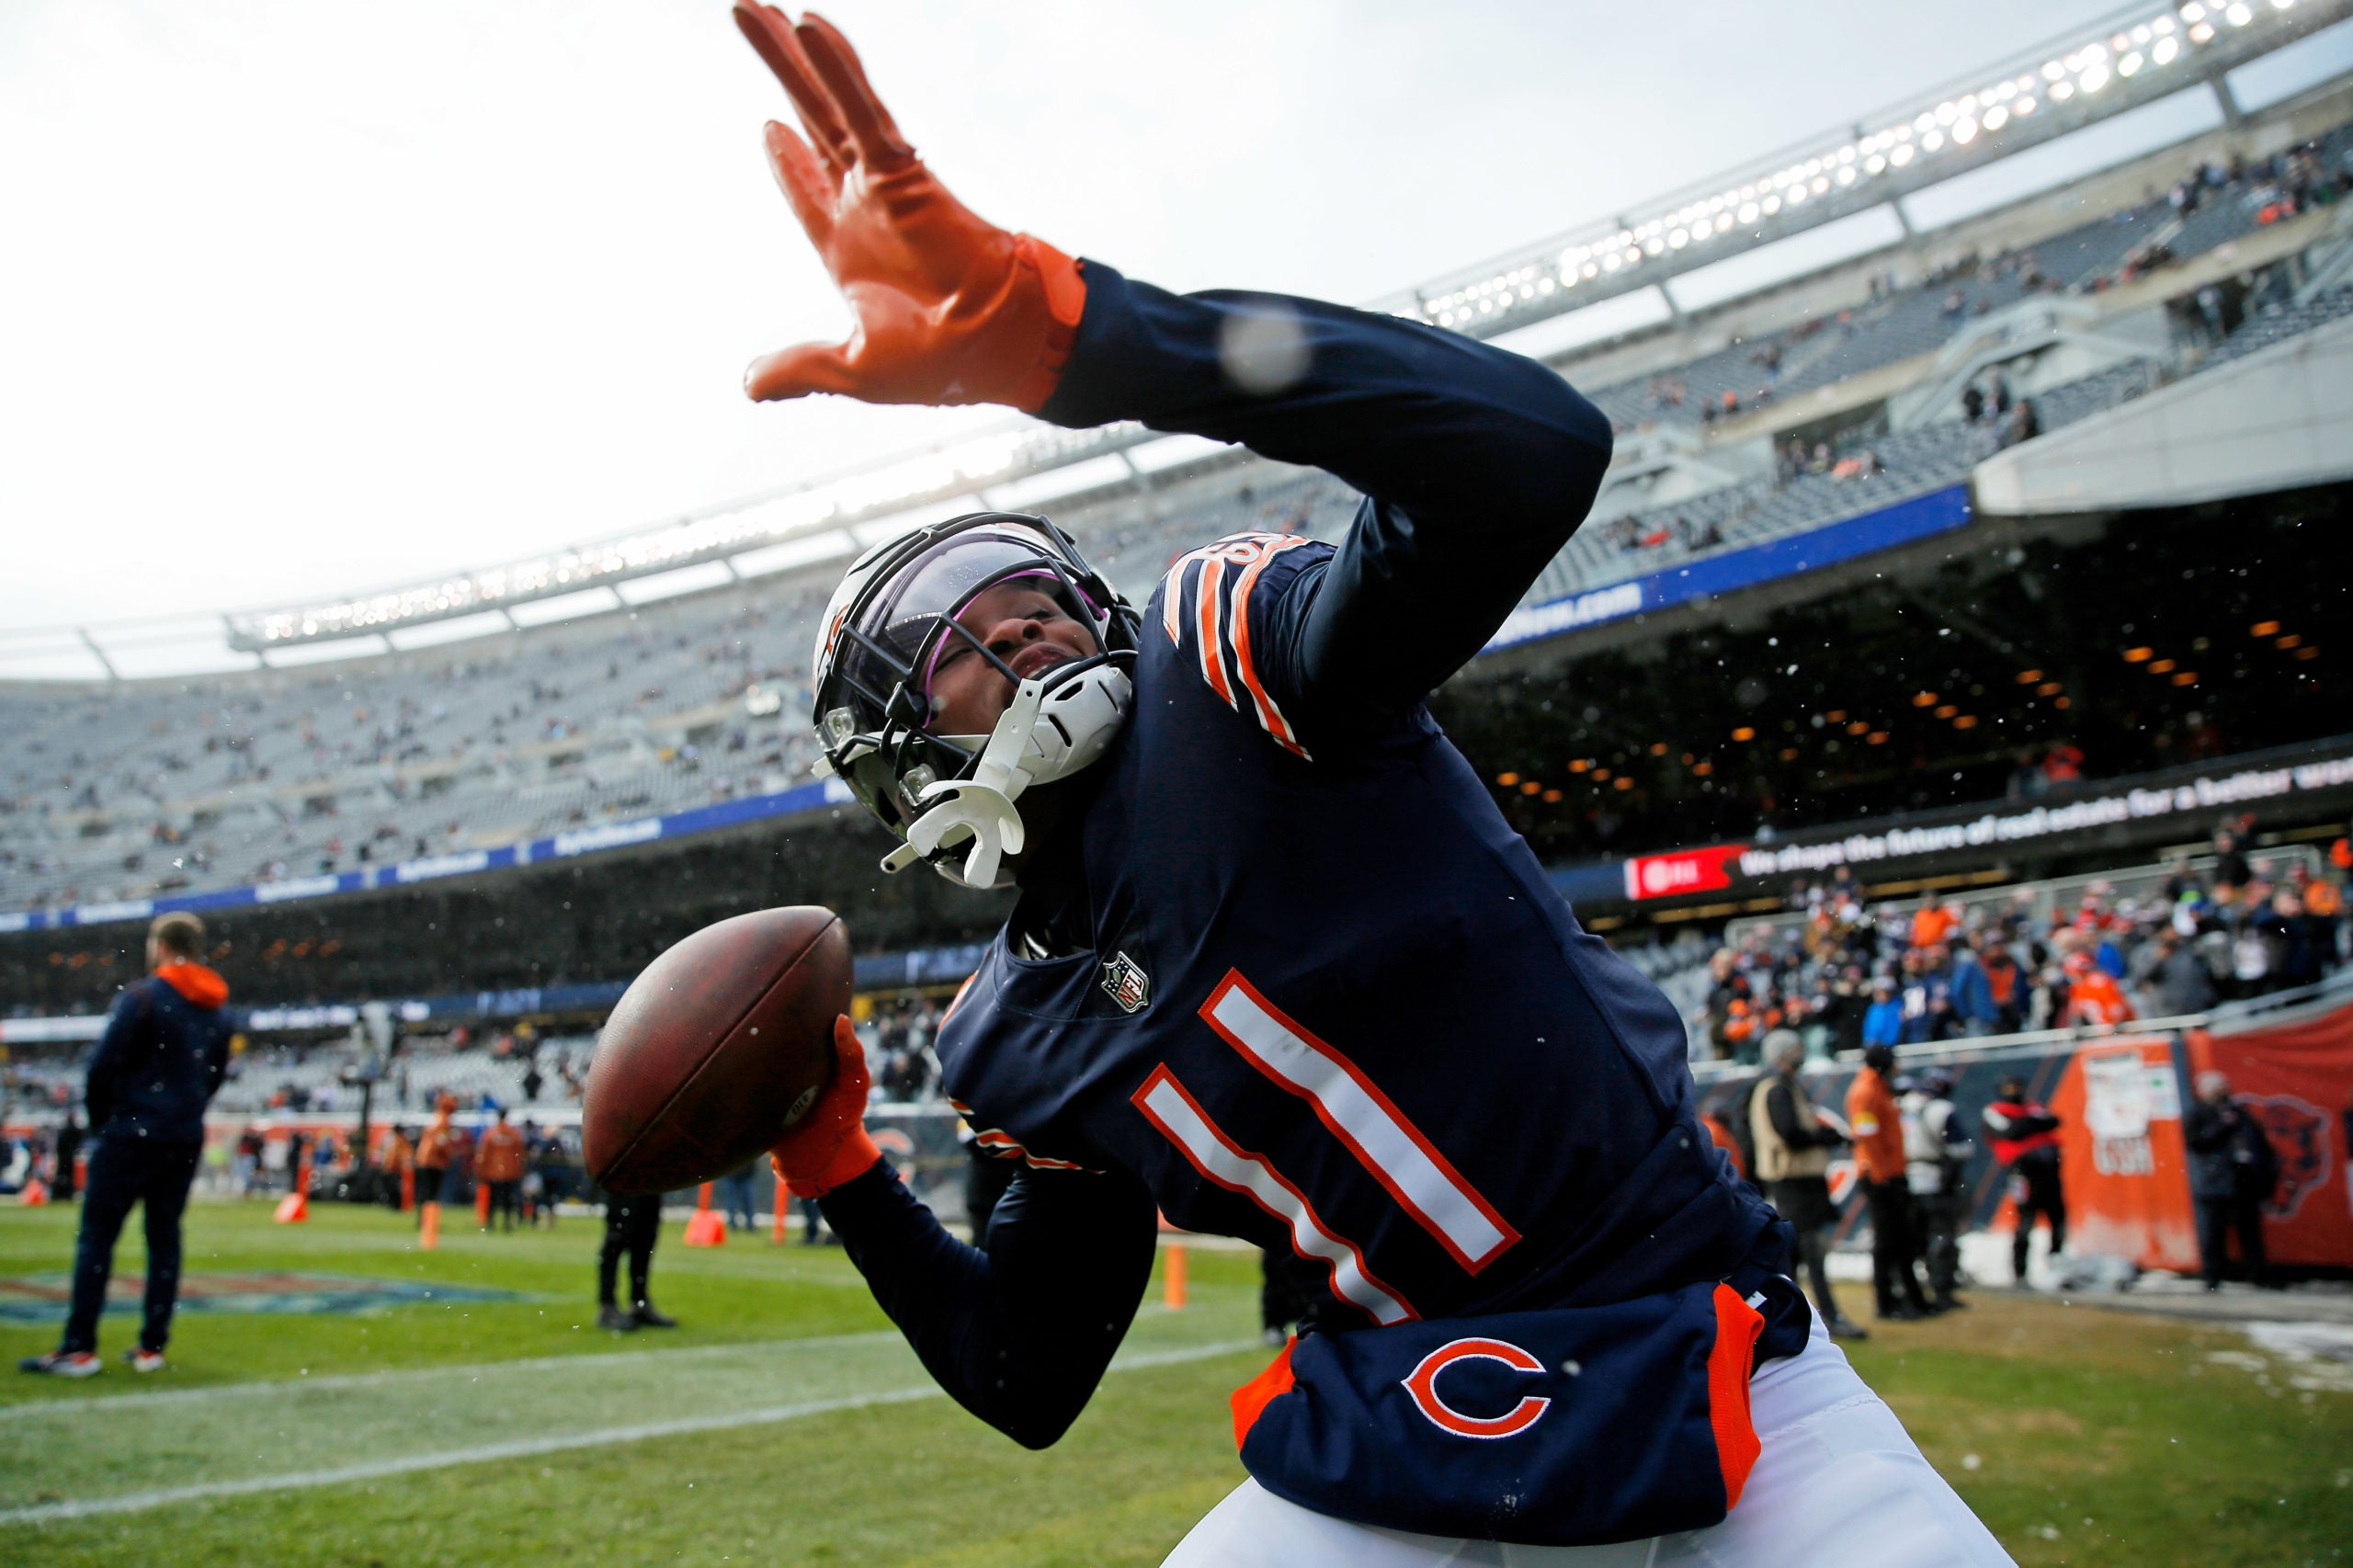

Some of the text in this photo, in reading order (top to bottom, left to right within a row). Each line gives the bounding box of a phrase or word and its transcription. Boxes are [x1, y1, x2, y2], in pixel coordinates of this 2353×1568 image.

[1843, 834, 1885, 862] the
[1885, 825, 1965, 857] future
[1965, 814, 1996, 846] of
[1996, 806, 2048, 841] real
[2047, 796, 2129, 832] estate
[2128, 788, 2174, 818] for
[2174, 786, 2197, 810] a
[2195, 768, 2291, 806] better
[1118, 974, 1142, 1006] NFL
[1131, 967, 1523, 1326] 11
[1401, 1337, 1552, 1439] C
